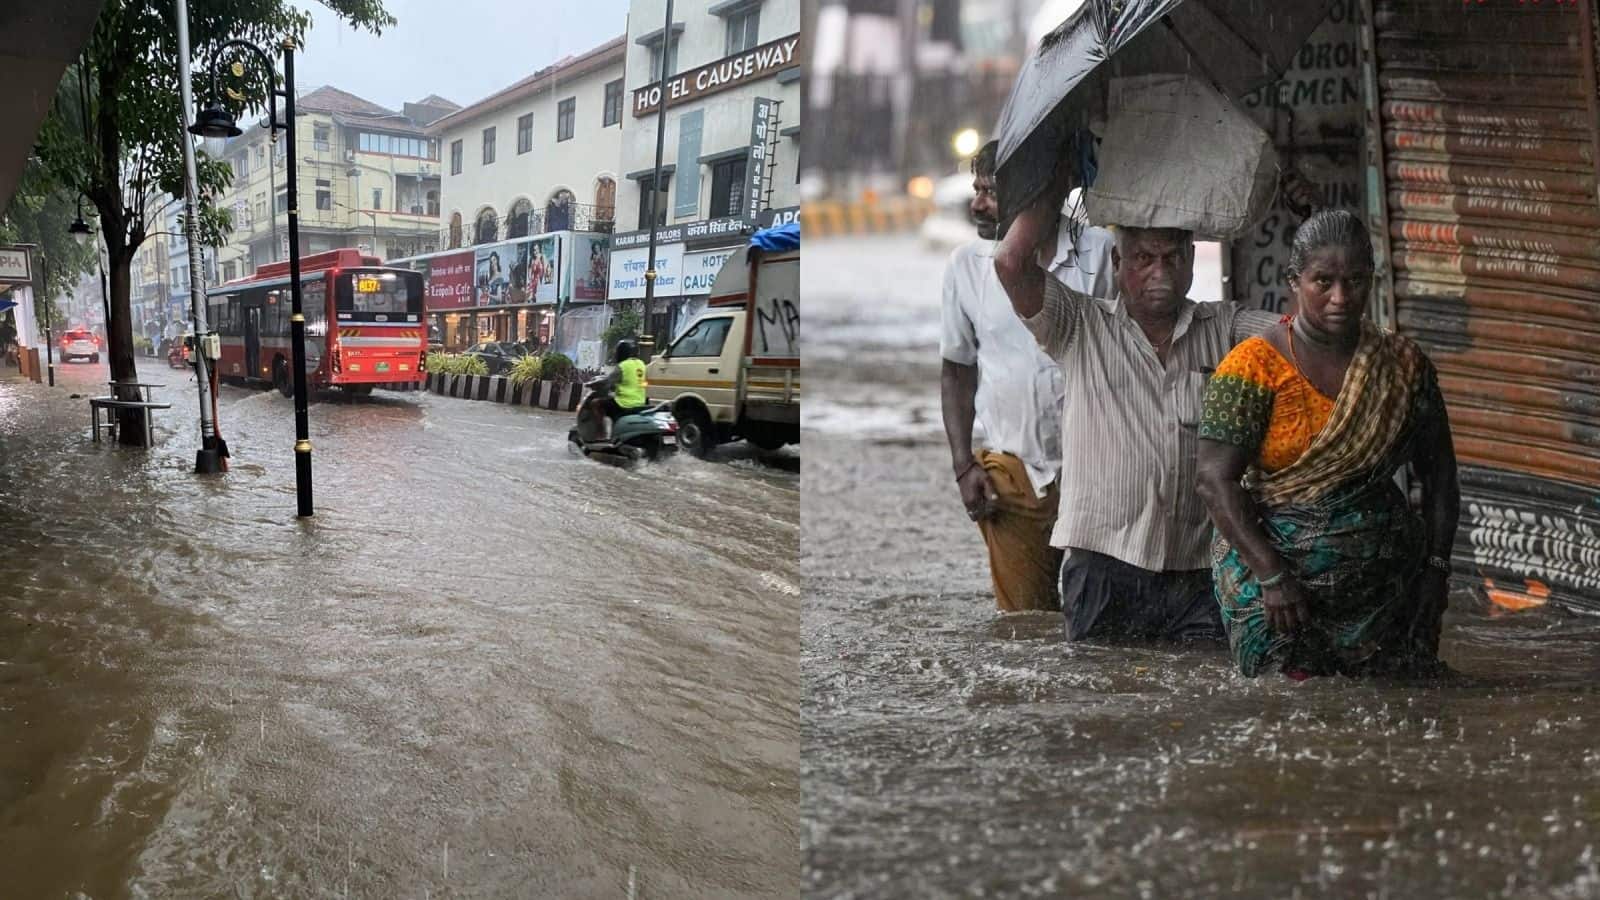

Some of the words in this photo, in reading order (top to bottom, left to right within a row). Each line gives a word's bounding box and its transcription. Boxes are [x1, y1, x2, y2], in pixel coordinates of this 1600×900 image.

[637, 77, 689, 110] HOEL
[696, 39, 797, 91] CAUSEWAY
[636, 233, 650, 244] SING
[656, 229, 681, 241] TAILORS
[702, 254, 727, 268] HOTE
[614, 277, 638, 290] Royal
[640, 276, 676, 288] Lther
[684, 274, 714, 290] CAUS
